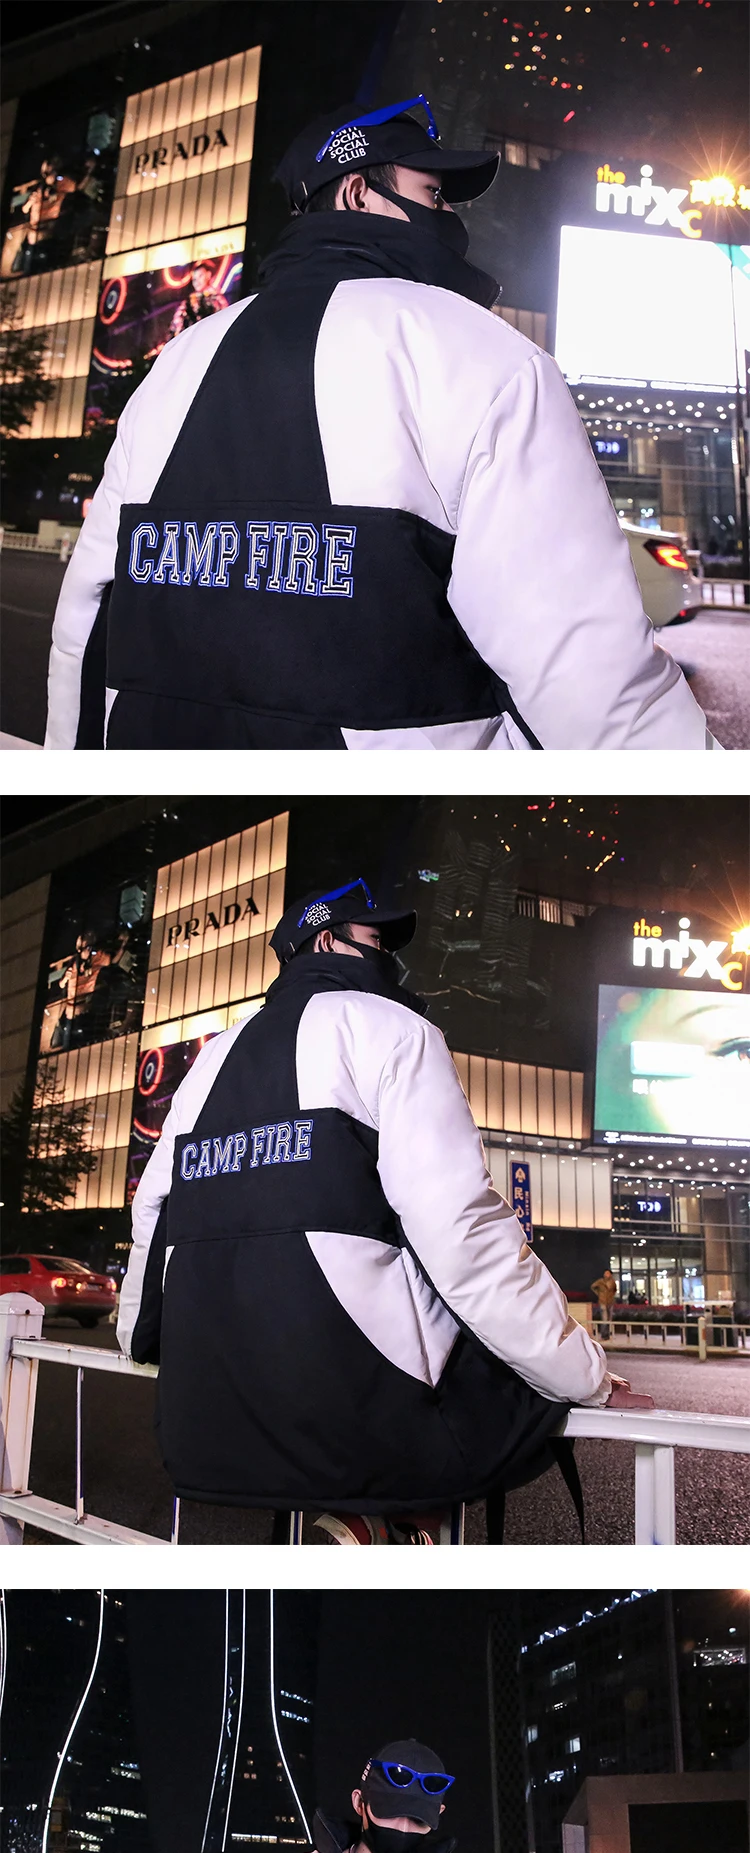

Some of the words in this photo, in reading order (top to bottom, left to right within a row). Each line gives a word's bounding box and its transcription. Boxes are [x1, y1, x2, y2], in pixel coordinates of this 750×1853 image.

[135, 128, 229, 175] PRADA
[330, 138, 370, 159] SOCIAL
[338, 148, 366, 164] CLUB
[597, 164, 626, 184] the
[128, 521, 240, 588] CAMP
[245, 521, 357, 598] FIRE
[166, 897, 261, 947] PRADA
[306, 908, 332, 925] SOCIAL
[312, 914, 331, 926] CLUB
[633, 918, 662, 937] the
[180, 1131, 248, 1180] CAMP
[249, 1119, 313, 1168] FIRE
